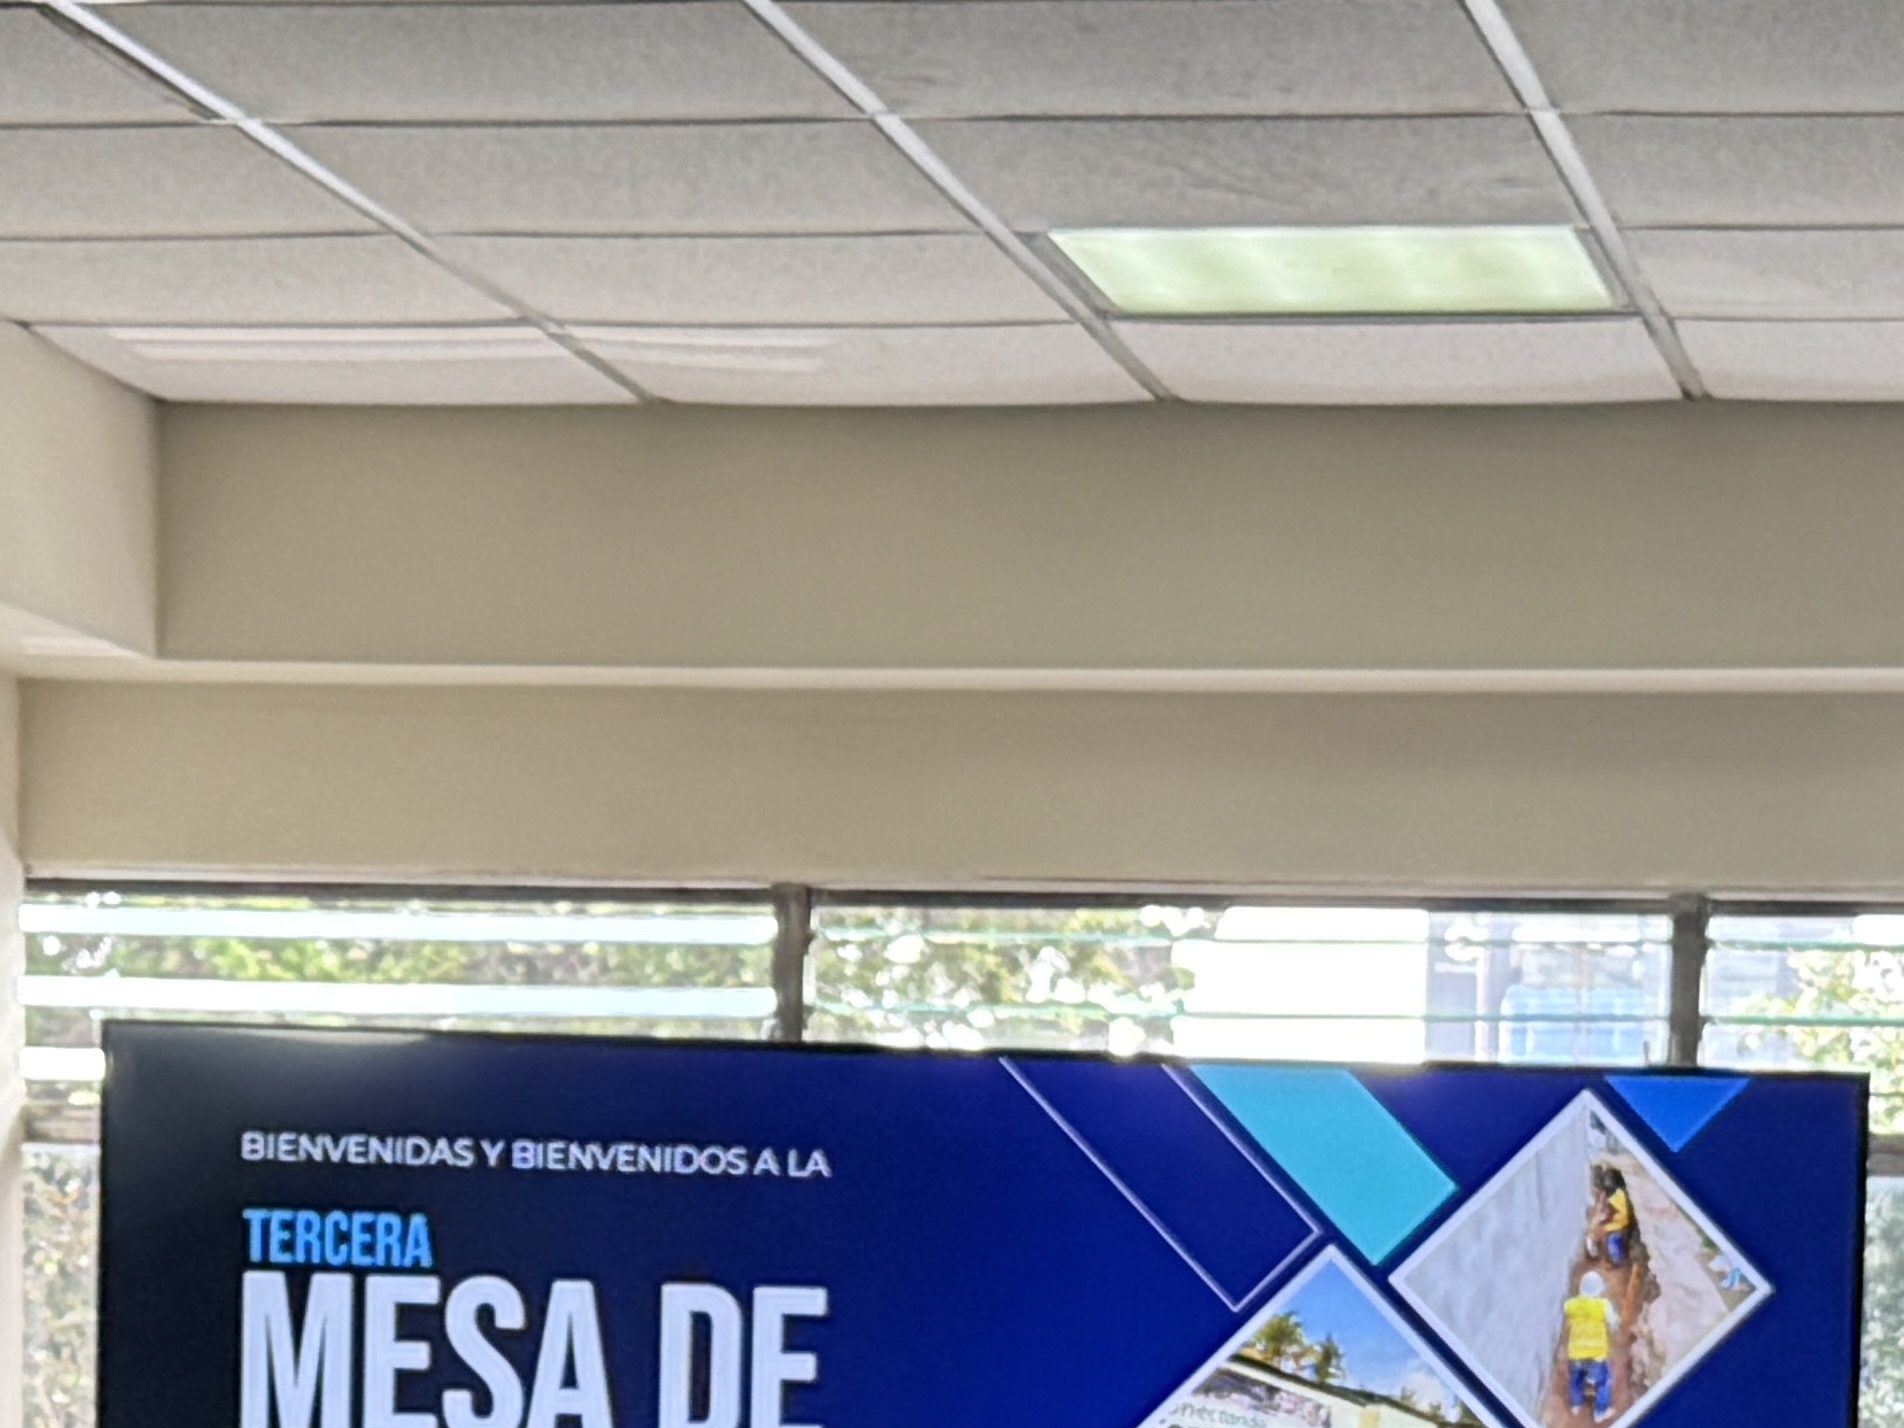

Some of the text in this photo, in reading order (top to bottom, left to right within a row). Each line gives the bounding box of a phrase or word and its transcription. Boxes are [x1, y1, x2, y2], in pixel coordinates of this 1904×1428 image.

[241, 1131, 831, 1178] BIENVENIDAS Y BIENVENIDOS A LA
[242, 1208, 433, 1268] TERCERA
